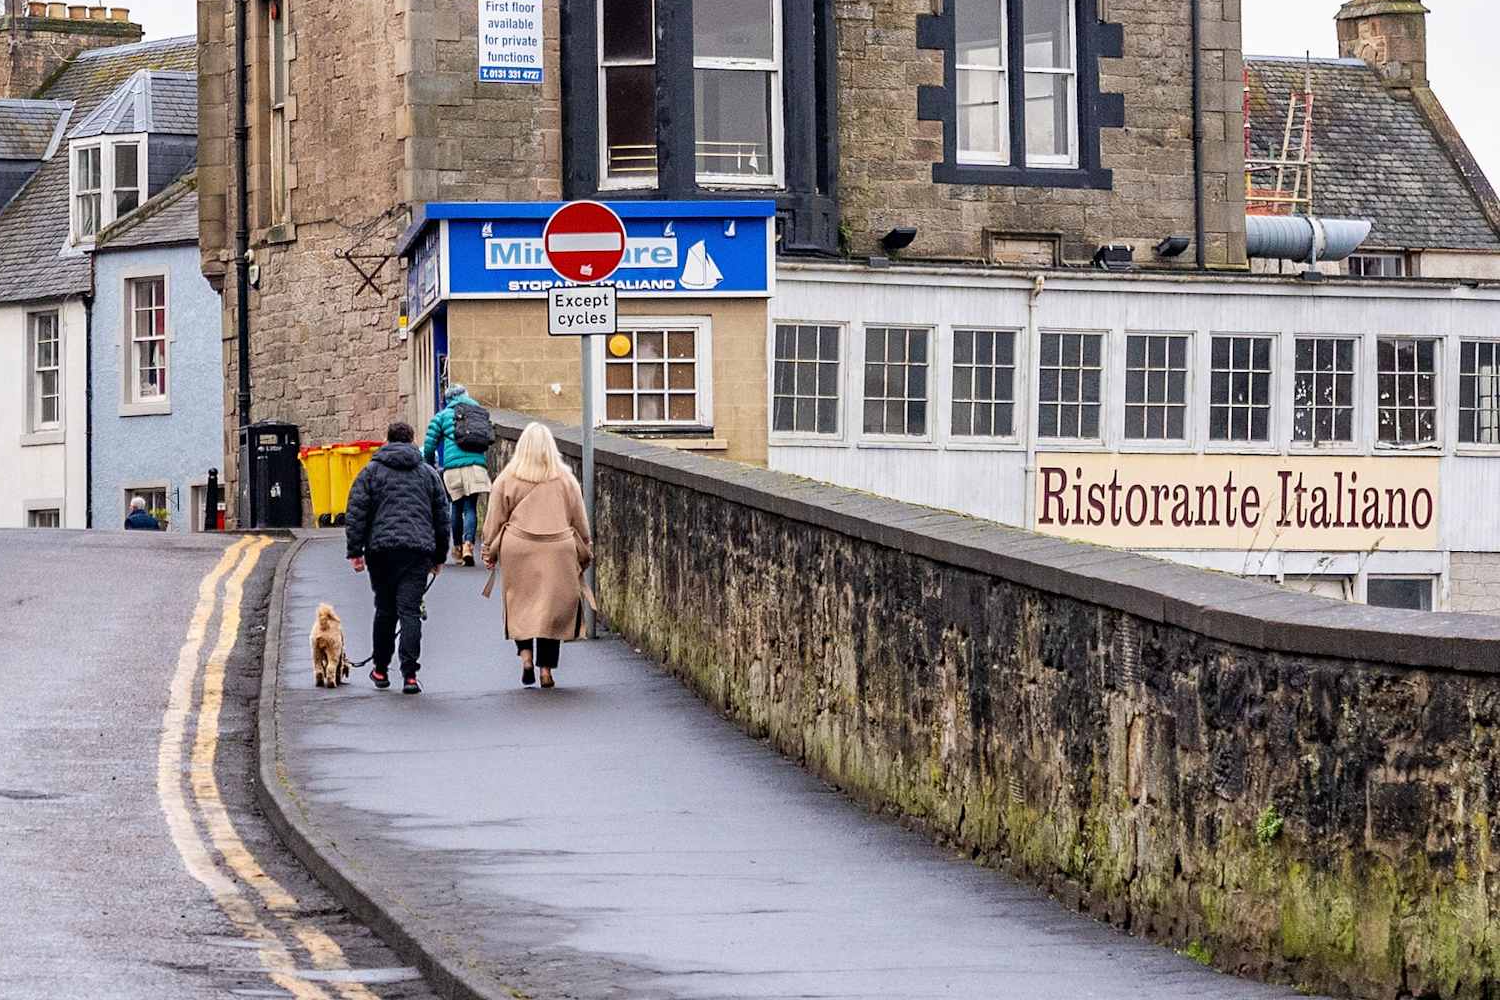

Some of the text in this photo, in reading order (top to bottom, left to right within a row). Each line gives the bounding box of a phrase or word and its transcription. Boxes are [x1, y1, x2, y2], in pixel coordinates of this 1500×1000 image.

[486, 0, 535, 13] First floor
[488, 18, 534, 30] available
[485, 34, 538, 48] for private
[488, 51, 536, 64] functions
[490, 242, 673, 265] Mirre
[555, 293, 609, 309] Except
[558, 311, 607, 328] cycles
[1038, 466, 1434, 531] Ristorante Italiano
